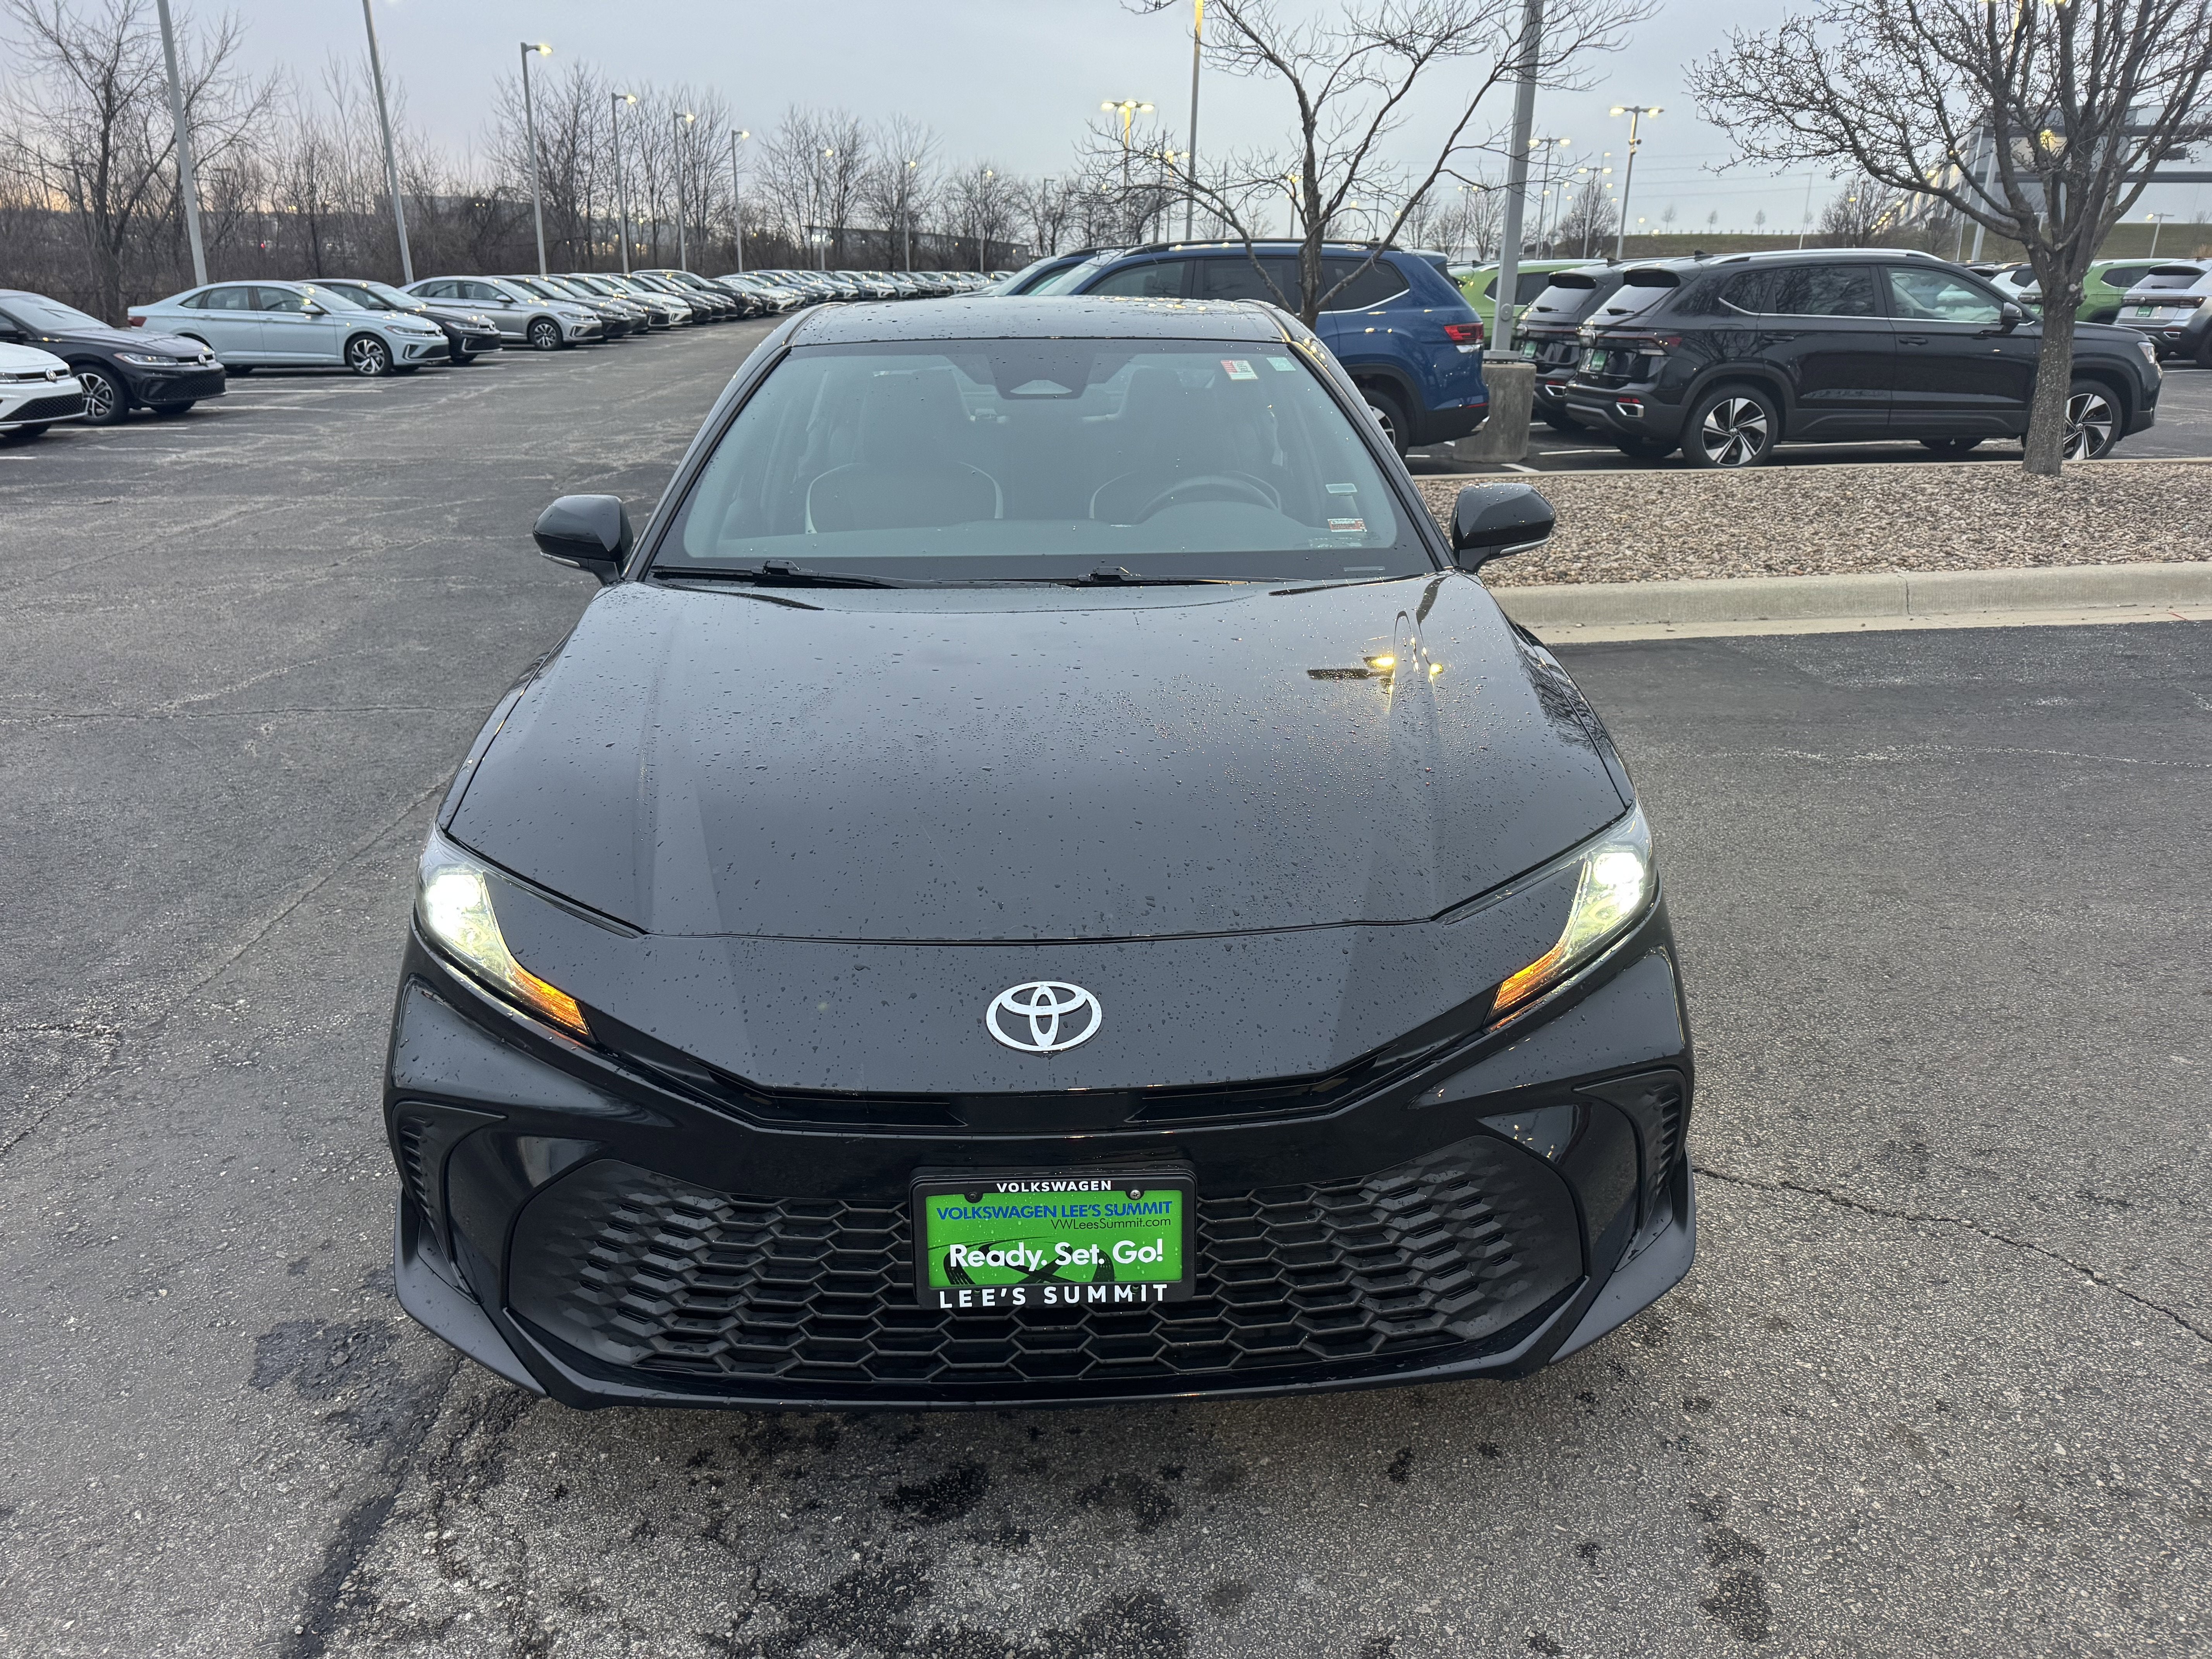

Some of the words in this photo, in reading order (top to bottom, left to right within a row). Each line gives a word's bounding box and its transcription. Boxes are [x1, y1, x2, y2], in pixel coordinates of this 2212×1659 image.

[997, 1180, 1111, 1193] VOLKSWAGEN
[937, 1205, 1057, 1220] VOLKSWAGEN
[1061, 1203, 1101, 1218] LEE'S
[1104, 1201, 1172, 1217] SUMMIT
[1051, 1218, 1171, 1230] VWLeesSummit.com
[950, 1242, 1047, 1271] Ready.
[1055, 1242, 1104, 1265] Set.
[1113, 1238, 1163, 1264] Go!
[939, 1288, 1026, 1308] LEE'S
[1044, 1284, 1167, 1304] SUMMIT
